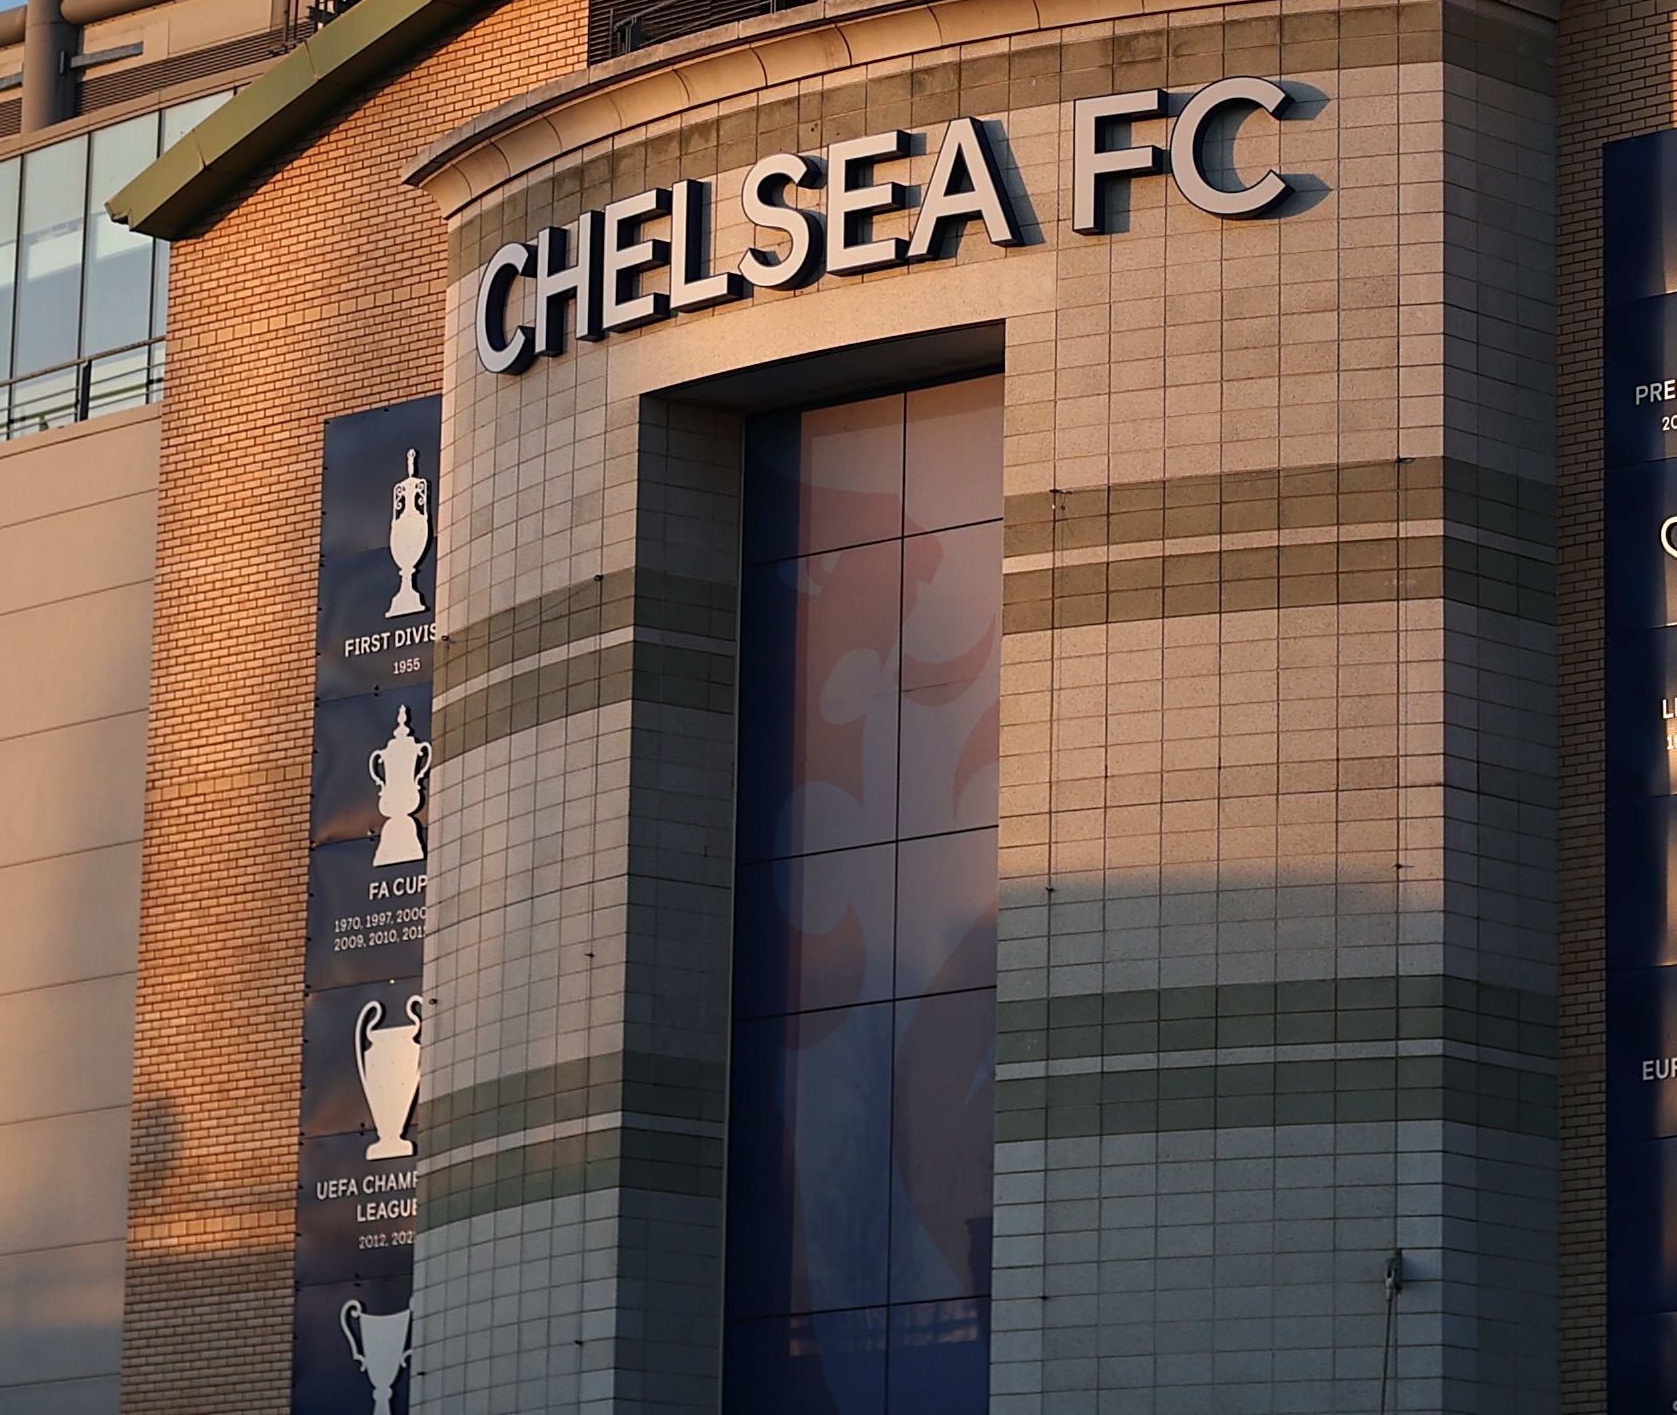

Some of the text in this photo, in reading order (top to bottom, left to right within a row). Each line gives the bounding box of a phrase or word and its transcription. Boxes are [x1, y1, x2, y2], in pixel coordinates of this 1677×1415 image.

[476, 76, 1294, 375] CHELSEA FC
[344, 632, 391, 658] FIRST
[393, 657, 421, 675] 1955
[368, 874, 428, 900] FA CUP
[334, 916, 363, 933] 1970,
[366, 911, 394, 928] 1997,
[333, 925, 426, 952] 2009, 2010, 201
[316, 1178, 358, 1200] UEFA
[359, 1230, 415, 1250] 2012, 202
